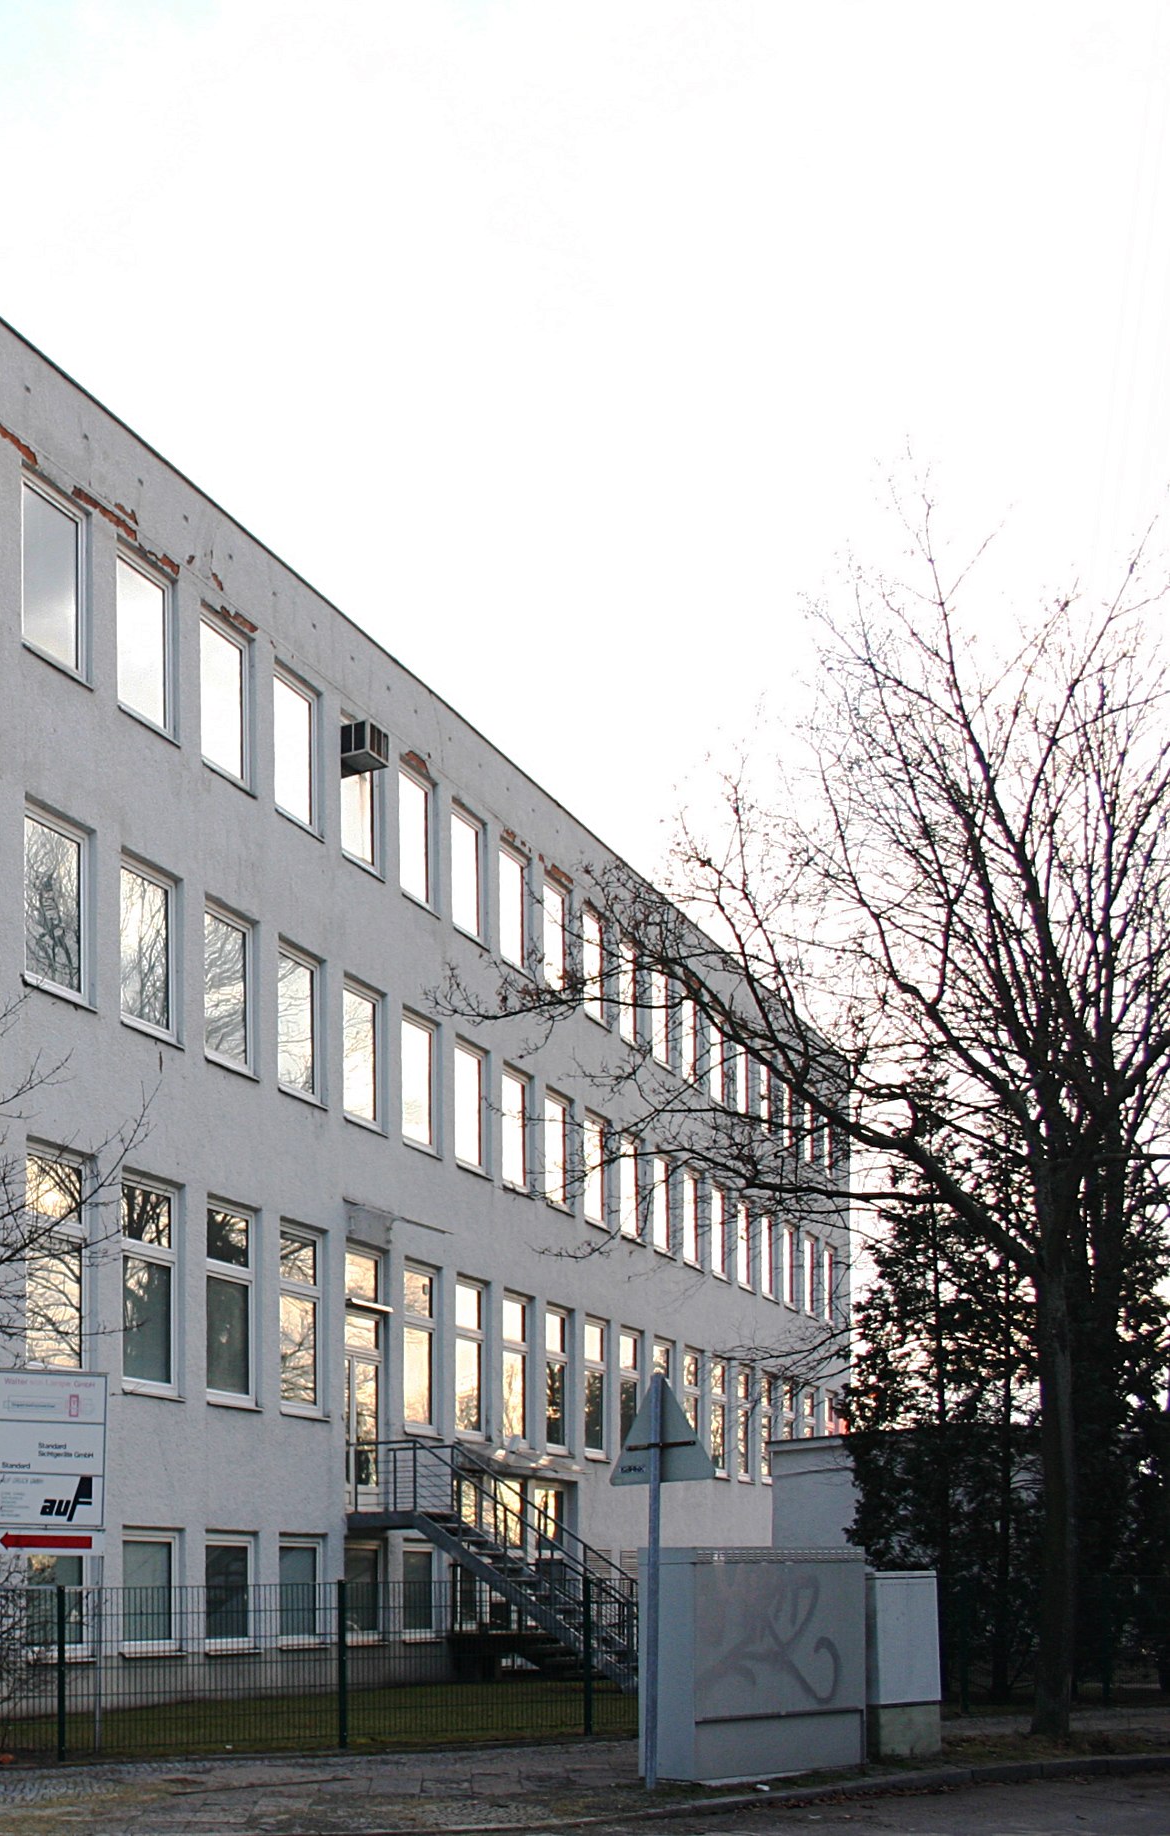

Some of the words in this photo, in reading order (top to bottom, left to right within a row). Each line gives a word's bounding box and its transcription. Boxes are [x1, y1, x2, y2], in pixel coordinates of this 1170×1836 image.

[4, 1377, 29, 1385] Walter
[73, 1379, 96, 1388] GmbH
[38, 1442, 67, 1450] Standard
[74, 1451, 94, 1459] GmbH
[1, 1461, 31, 1469] Standard
